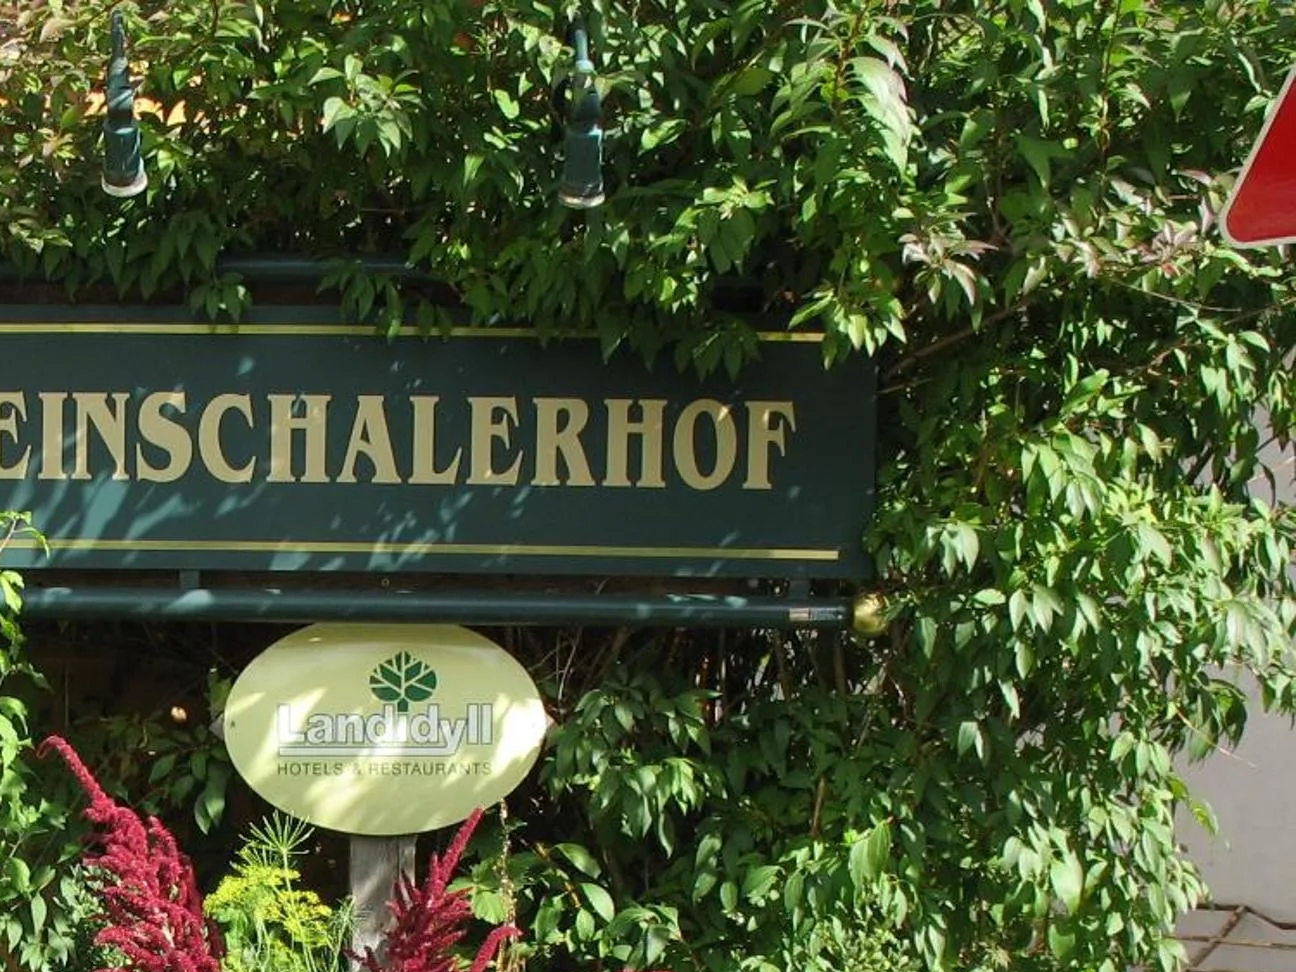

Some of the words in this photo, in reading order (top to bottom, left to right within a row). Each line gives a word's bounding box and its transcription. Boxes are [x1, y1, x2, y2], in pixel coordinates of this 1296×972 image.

[277, 703, 494, 757] Landidyll
[277, 762, 343, 777] HOTELS
[368, 762, 493, 777] RESTAURANTS
